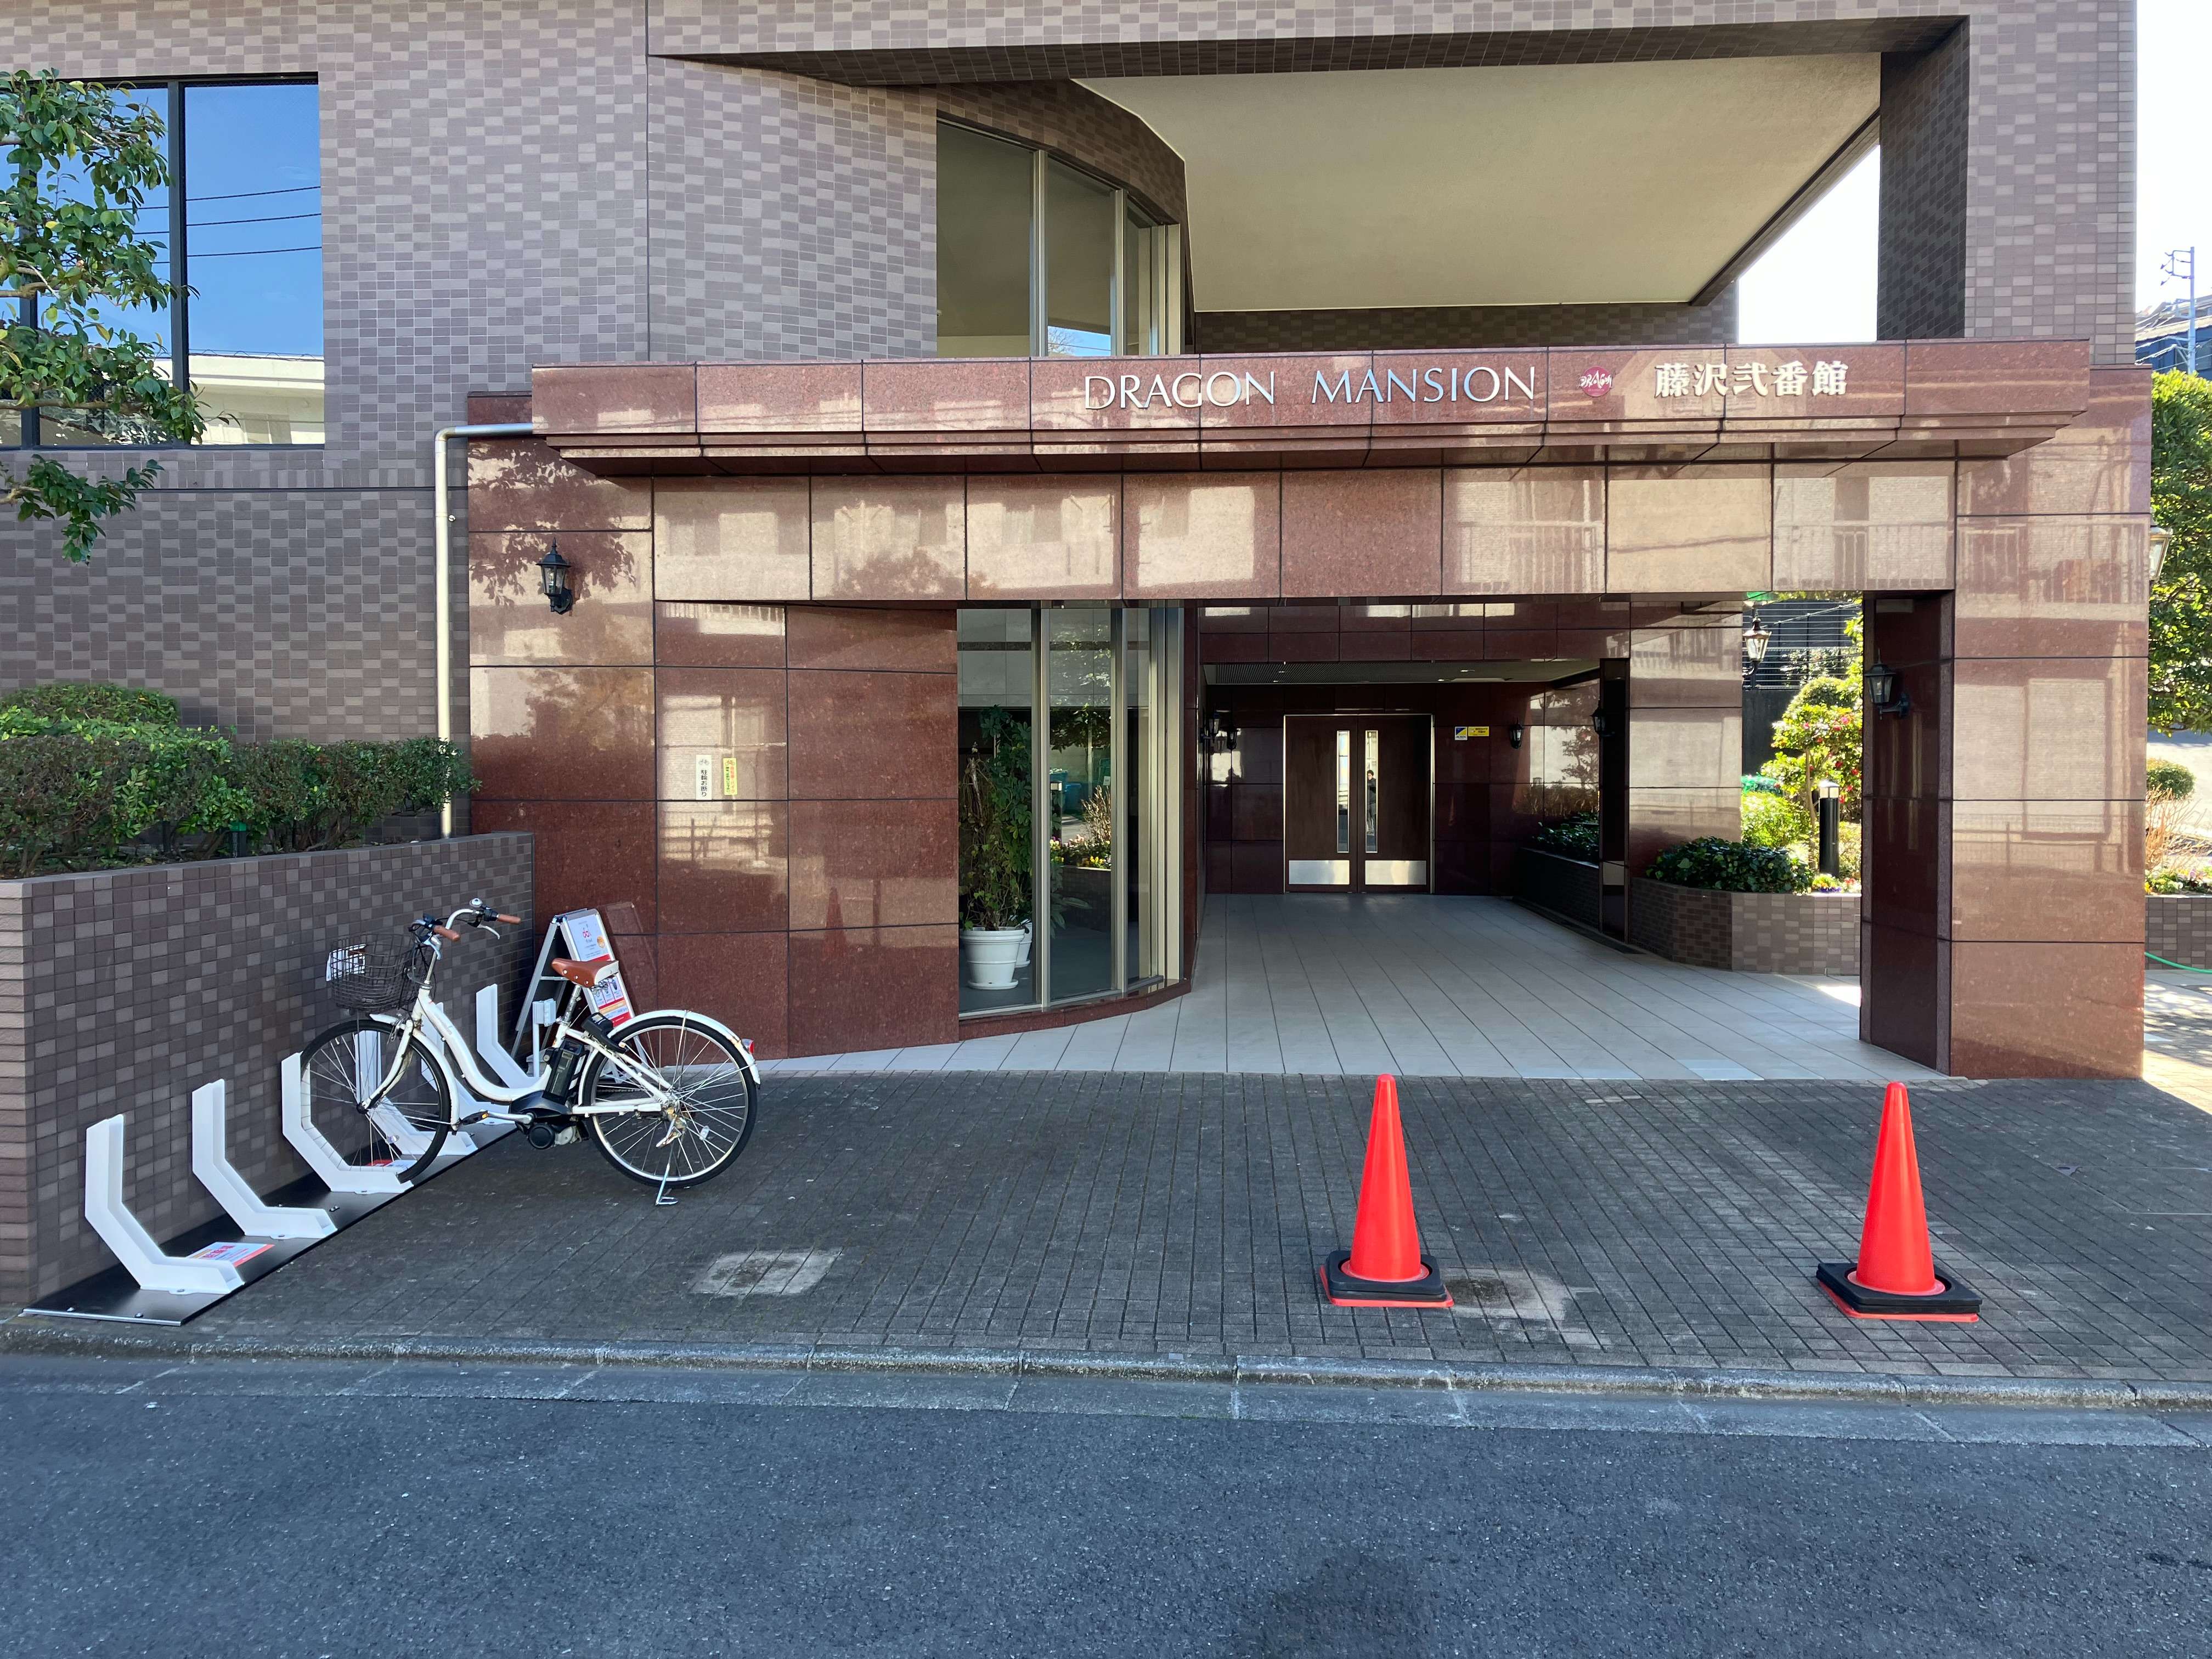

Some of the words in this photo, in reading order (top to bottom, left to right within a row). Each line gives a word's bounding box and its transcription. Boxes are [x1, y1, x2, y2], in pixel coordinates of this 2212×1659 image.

[1085, 371, 1275, 410] DRAGON
[1311, 366, 1536, 404] MANSION
[1654, 360, 1849, 398] 藤沢弐番館
